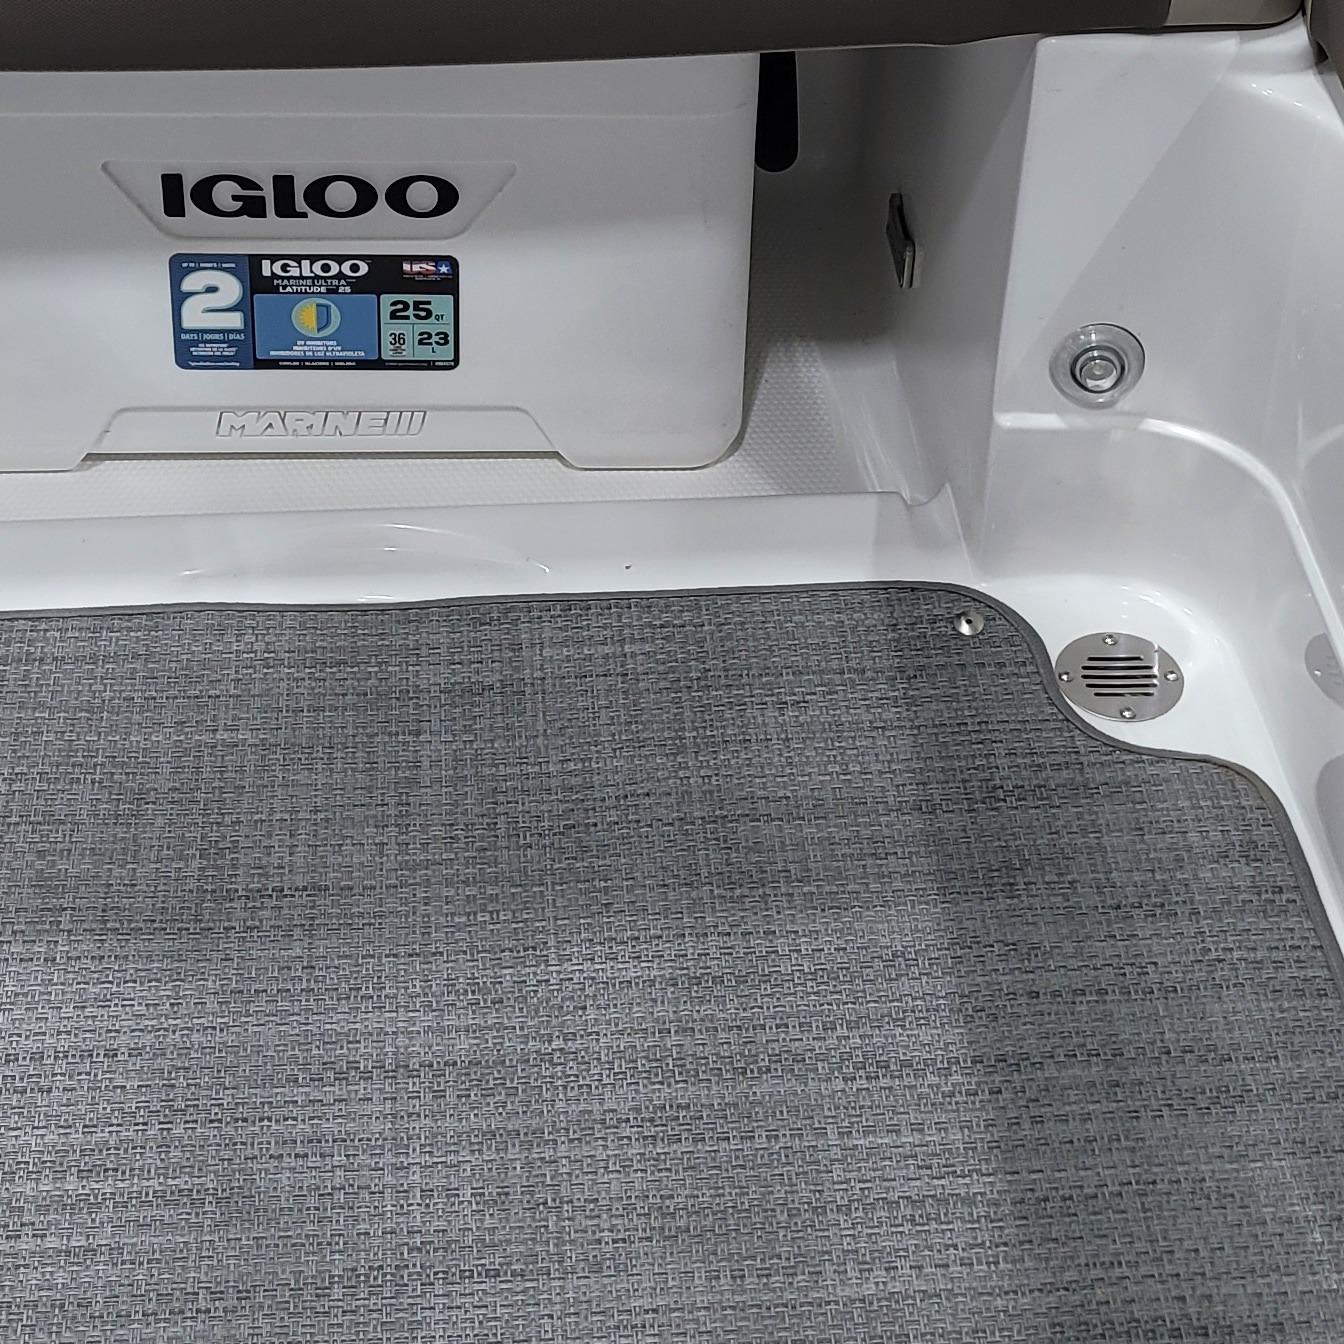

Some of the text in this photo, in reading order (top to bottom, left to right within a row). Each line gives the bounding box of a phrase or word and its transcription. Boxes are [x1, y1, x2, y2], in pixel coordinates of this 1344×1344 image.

[160, 173, 460, 219] IGLOO
[261, 259, 369, 277] IGLOO
[180, 269, 245, 330] 2
[389, 299, 445, 322] 25 QT
[388, 331, 450, 347] 36 23
